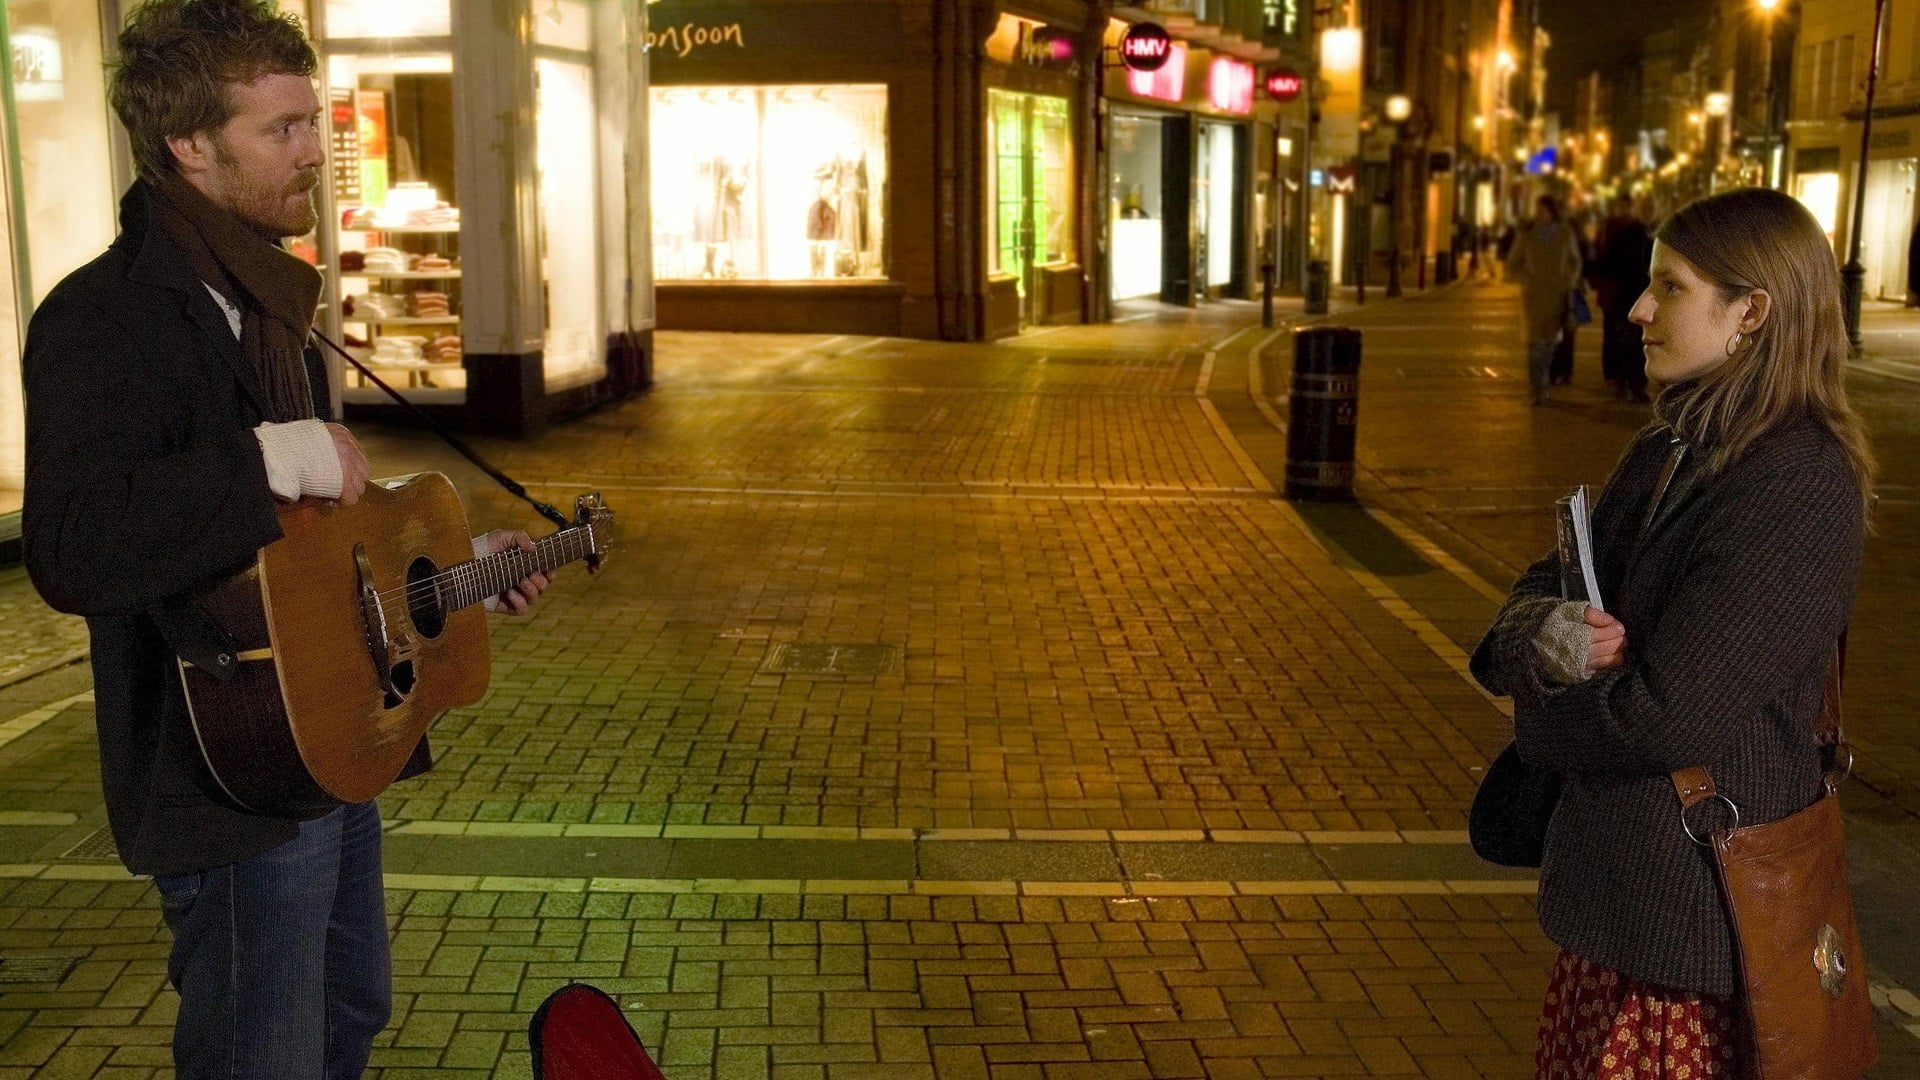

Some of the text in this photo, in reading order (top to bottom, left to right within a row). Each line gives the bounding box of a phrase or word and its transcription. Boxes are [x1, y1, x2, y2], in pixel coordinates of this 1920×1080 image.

[647, 23, 744, 57] onsoon
[1125, 38, 1167, 56] HMV
[1268, 78, 1299, 91] HMV
